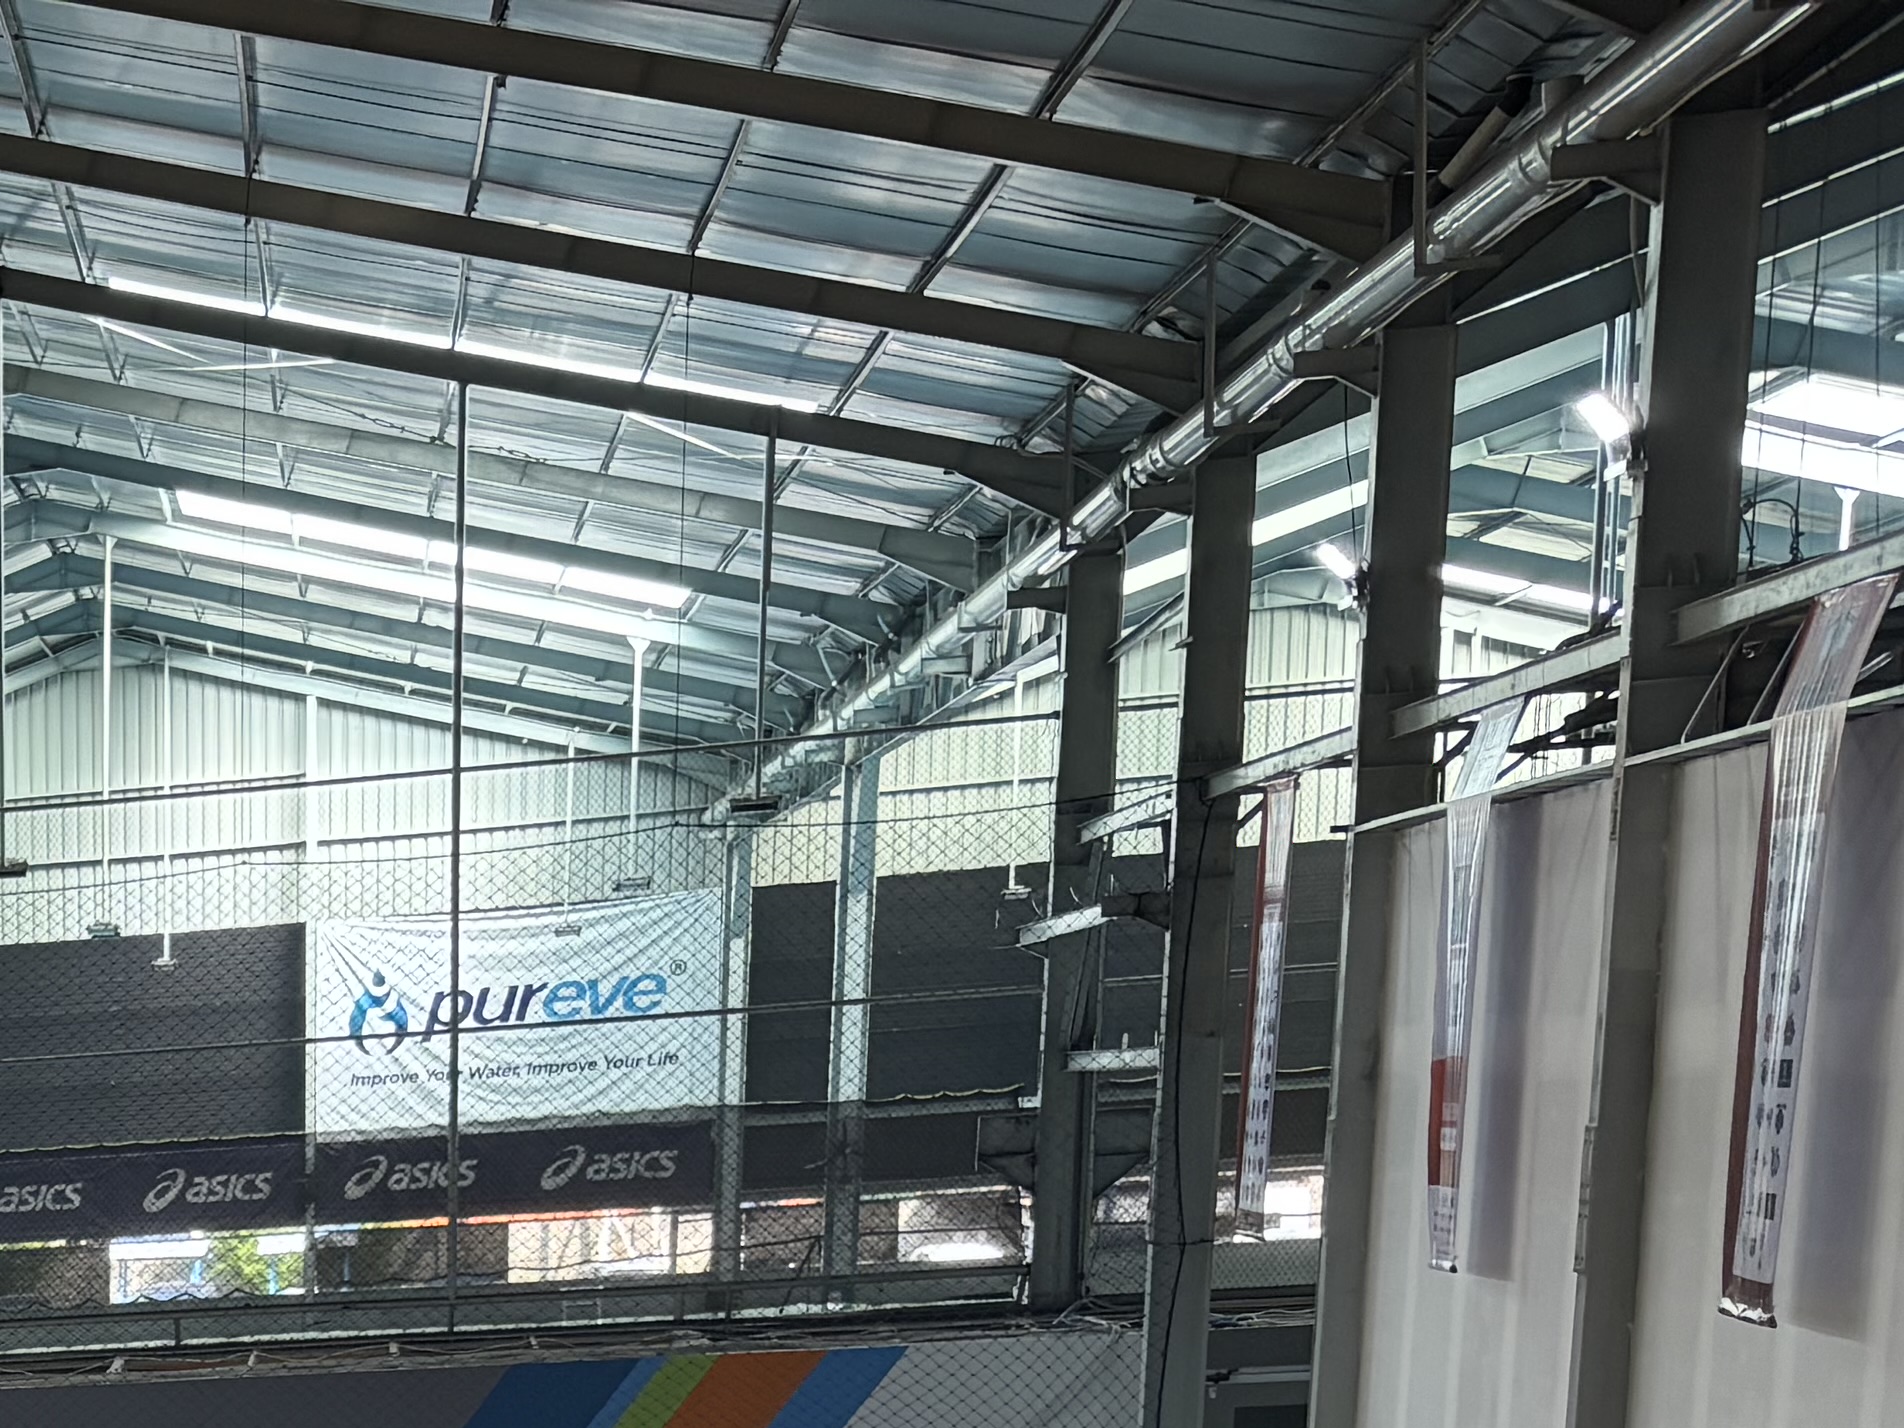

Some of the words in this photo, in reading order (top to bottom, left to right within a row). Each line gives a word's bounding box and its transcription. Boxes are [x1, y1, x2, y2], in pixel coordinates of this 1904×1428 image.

[422, 973, 668, 1044] pureve
[350, 1072, 420, 1088] Improve
[526, 1058, 598, 1077] Improve
[604, 1055, 643, 1071] Your
[647, 1051, 679, 1067] Life
[586, 1150, 679, 1181] asics
[186, 1170, 273, 1203] asics
